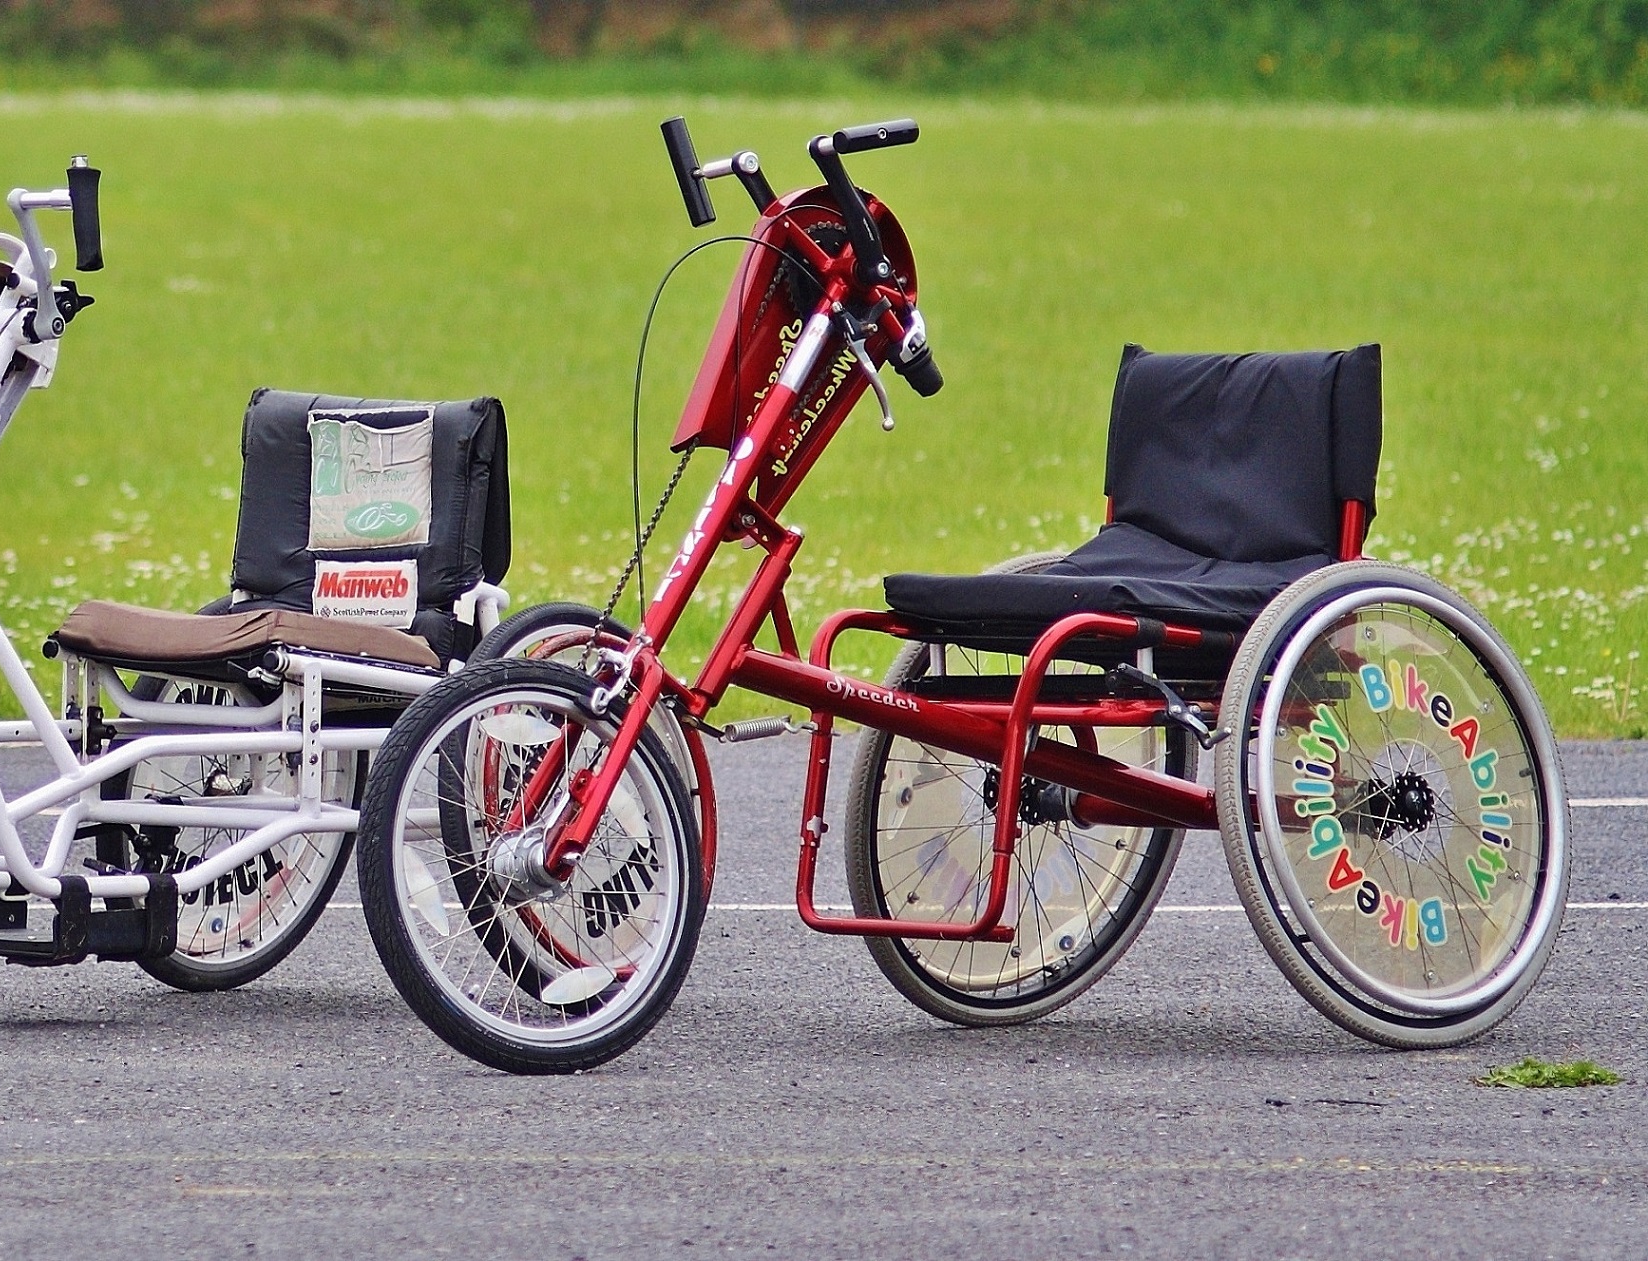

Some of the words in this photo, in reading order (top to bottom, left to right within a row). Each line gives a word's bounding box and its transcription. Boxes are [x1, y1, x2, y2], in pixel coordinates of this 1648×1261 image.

[316, 569, 409, 599] Manweb
[380, 607, 407, 618] Company
[826, 675, 921, 713] Speeder
